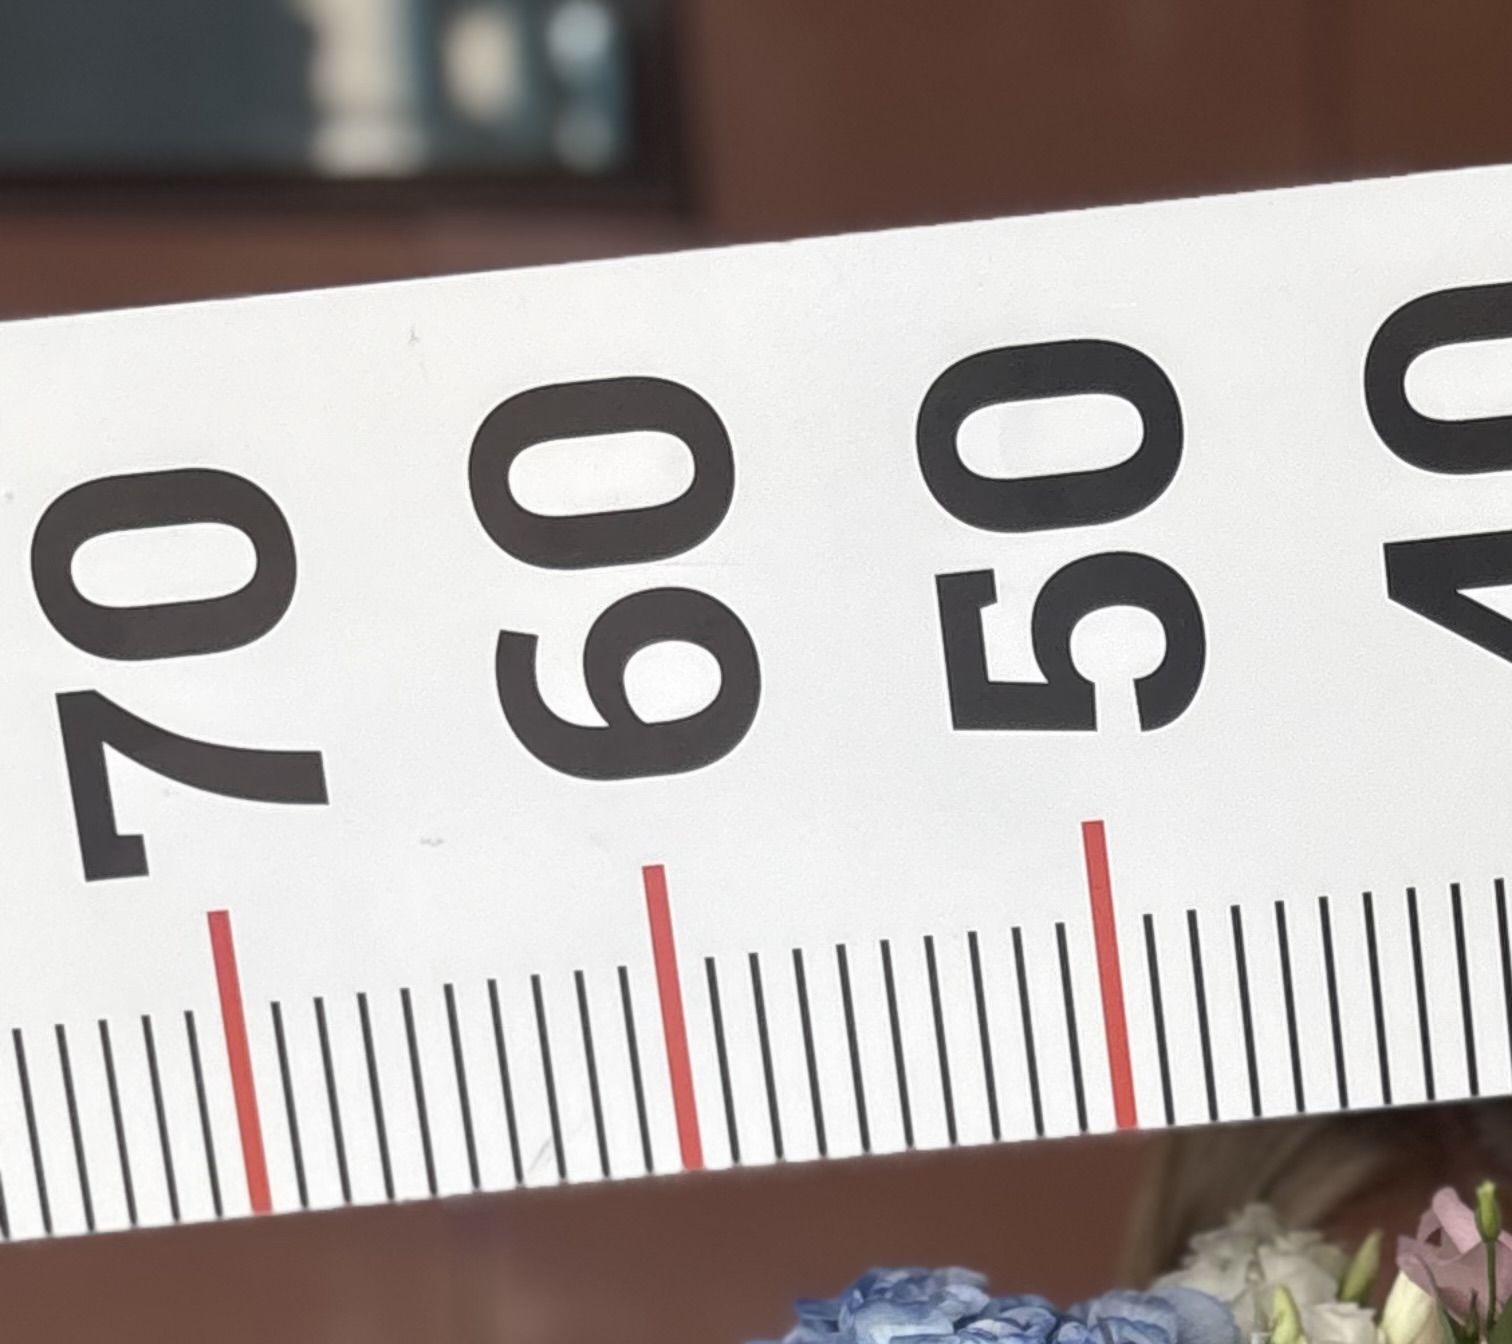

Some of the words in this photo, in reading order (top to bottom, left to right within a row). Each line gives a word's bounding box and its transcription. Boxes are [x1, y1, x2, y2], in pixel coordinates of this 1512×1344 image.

[30, 467, 328, 881] 70
[468, 376, 761, 780] 60
[916, 338, 1206, 731] 50
